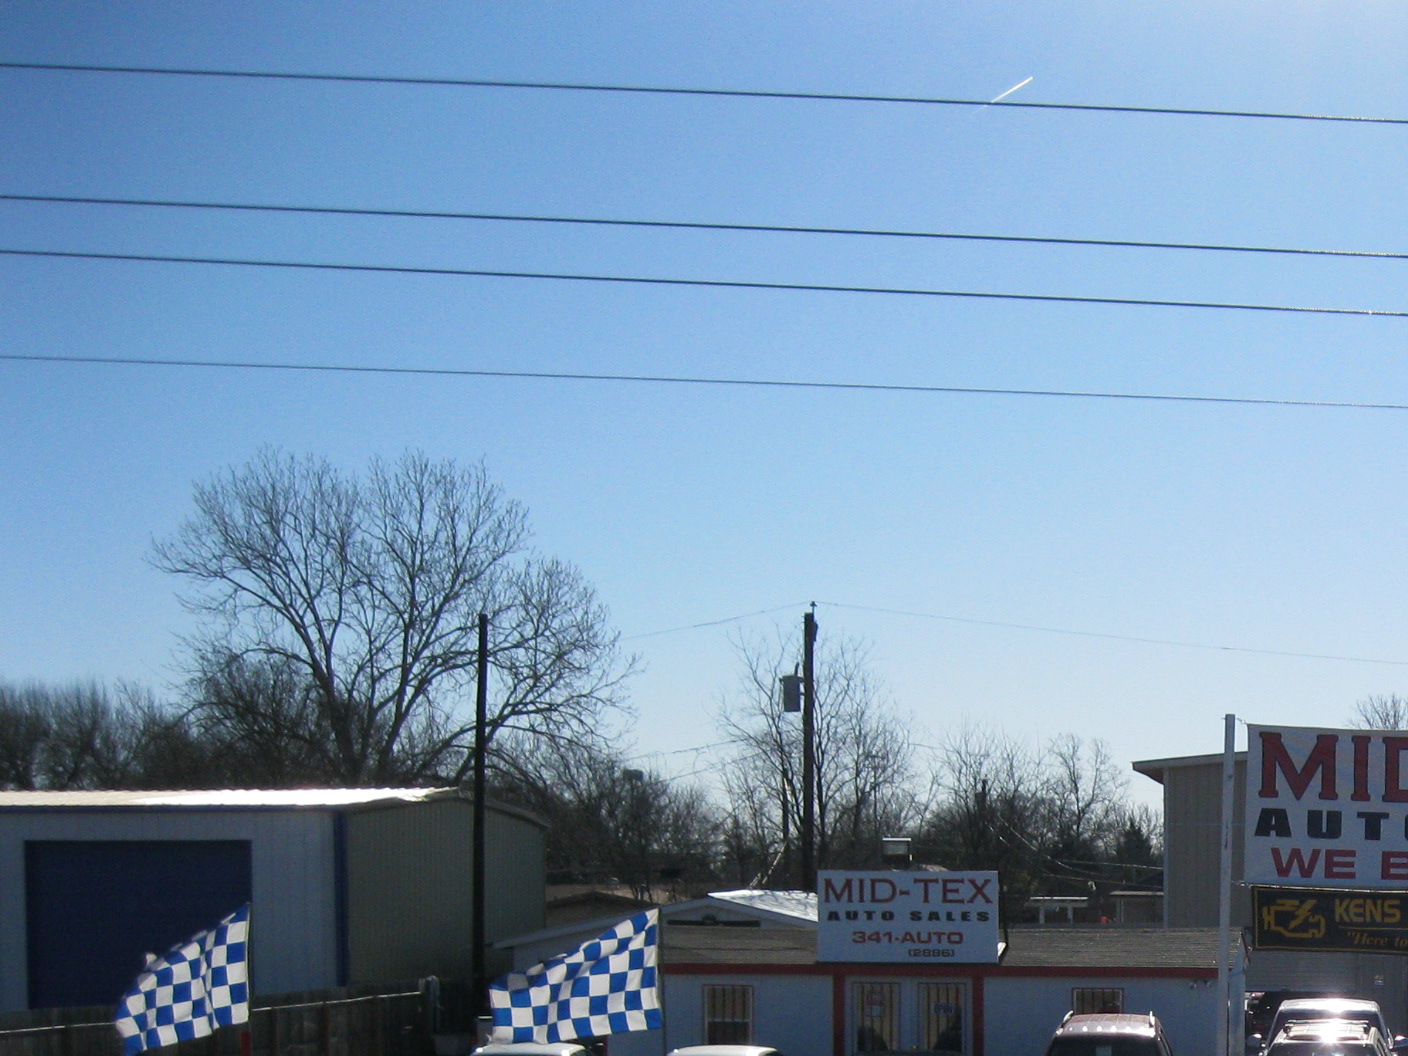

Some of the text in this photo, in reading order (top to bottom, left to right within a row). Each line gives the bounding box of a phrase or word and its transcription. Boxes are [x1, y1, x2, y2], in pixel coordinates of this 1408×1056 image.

[1271, 847, 1357, 880] WE
[823, 877, 994, 904] MID-TEX
[827, 910, 990, 922] AUTO SALES
[1334, 898, 1401, 923] KENS
[1394, 936, 1408, 948] to
